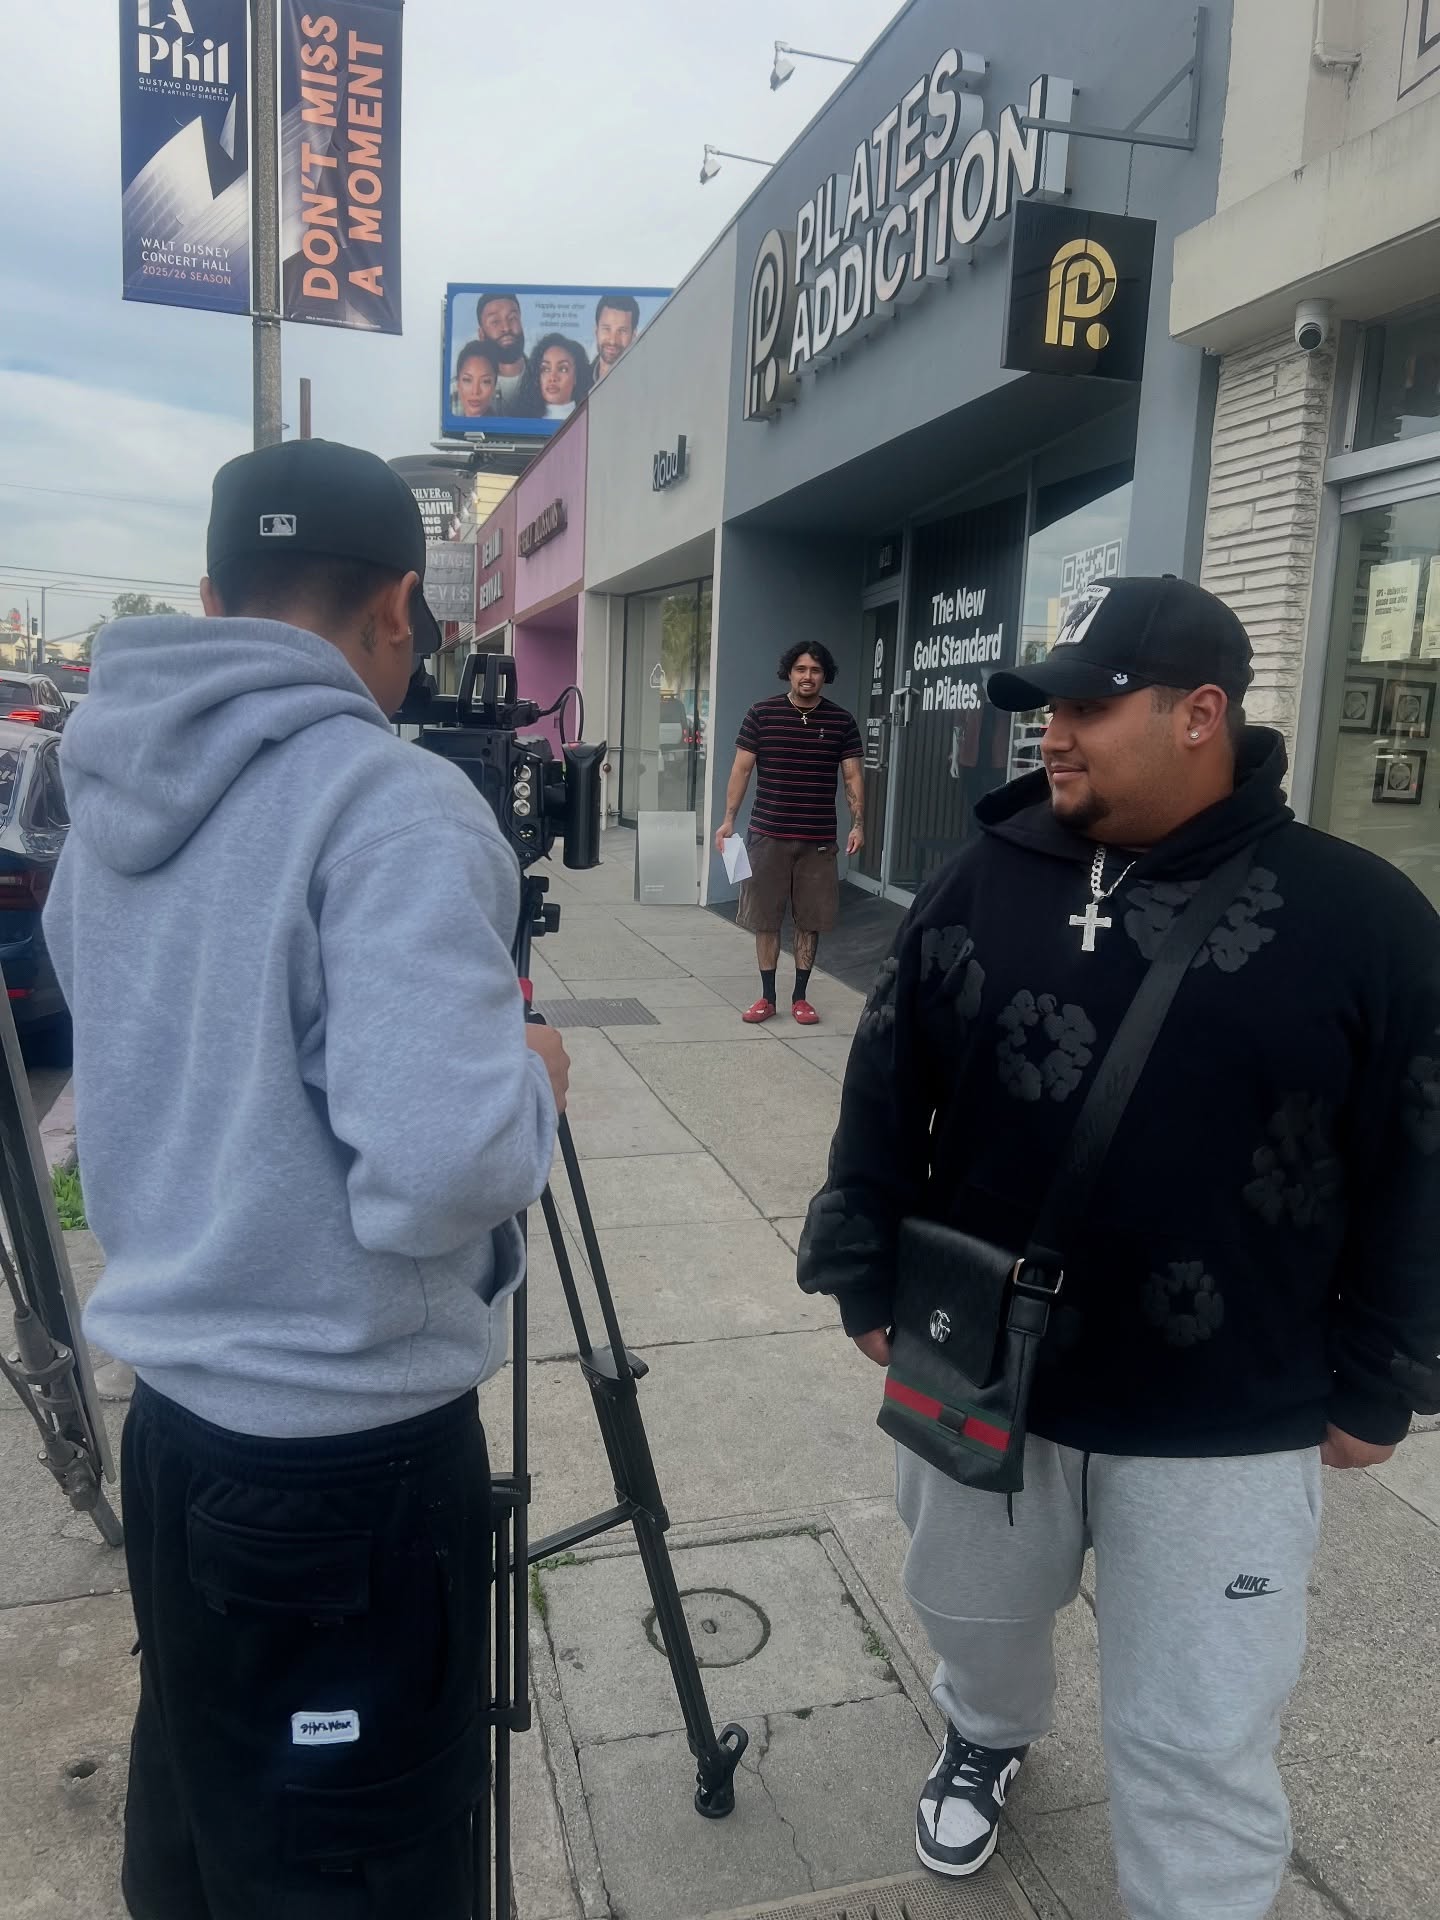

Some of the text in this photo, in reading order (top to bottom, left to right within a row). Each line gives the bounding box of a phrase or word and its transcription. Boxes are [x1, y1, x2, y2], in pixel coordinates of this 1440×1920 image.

[138, 32, 229, 85] Phil
[138, 77, 229, 95] GUSTAVO DUDAMEL
[138, 85, 159, 93] MUSIC
[167, 89, 196, 98] ARTISTIC
[198, 93, 229, 102] DIRECTOR
[301, 14, 339, 300] DON'T MISS
[348, 30, 384, 297] A MOMENT
[795, 48, 970, 286] PILATES
[788, 74, 1060, 374] ADDICTION
[141, 236, 230, 258] WALT DISNEY
[141, 250, 232, 272] CONCERT HALL
[142, 264, 232, 285] 2025/26 SEASON
[418, 501, 454, 515] SMITH
[430, 552, 472, 569] NTAGE
[426, 584, 470, 601] EVIS
[932, 587, 986, 626] The New
[913, 623, 1003, 671] Gold Standard
[922, 677, 934, 711] in
[934, 675, 981, 711] Pilates.
[1233, 1573, 1271, 1593] NIKE
